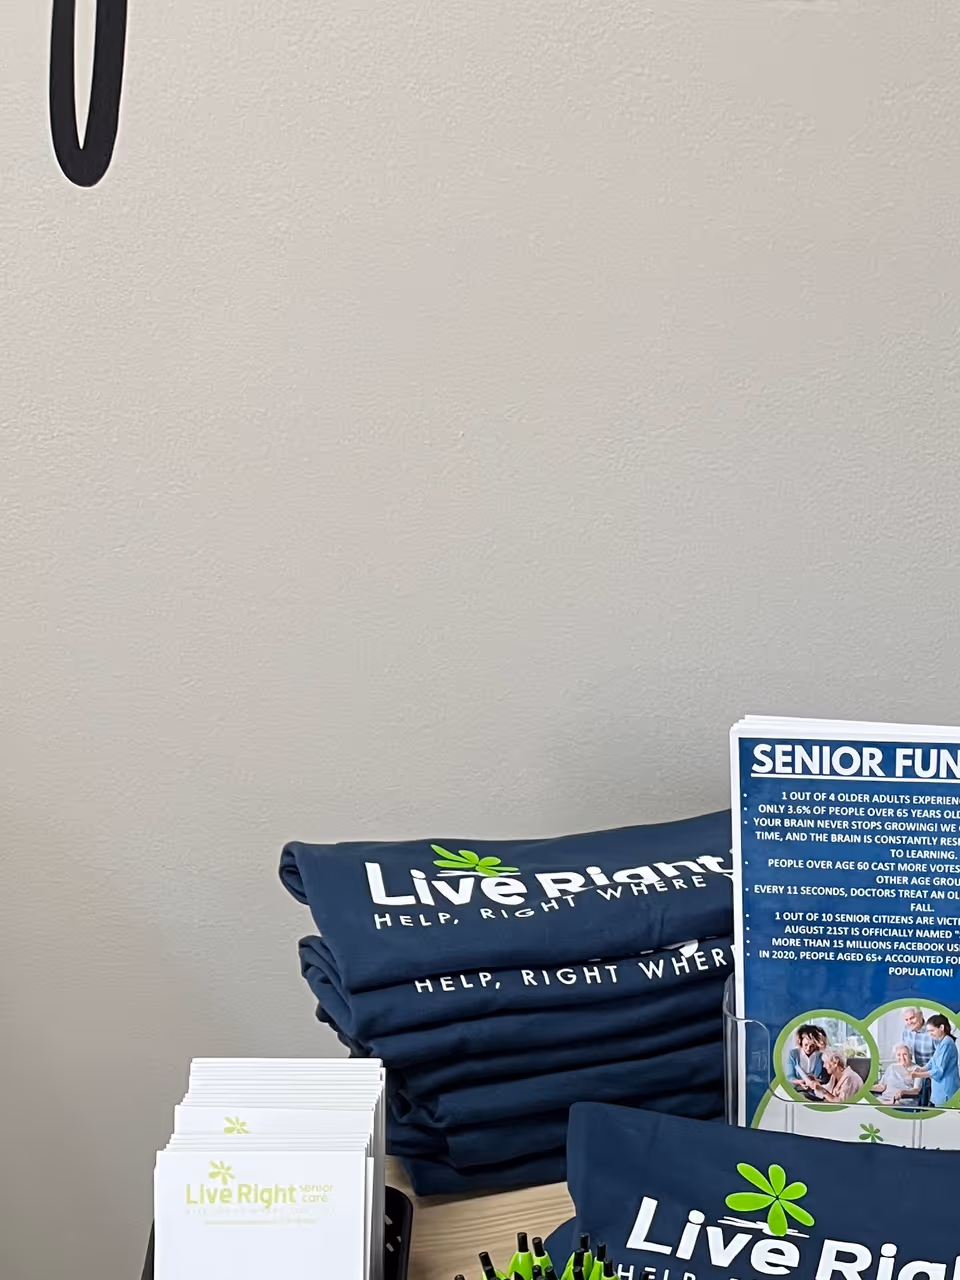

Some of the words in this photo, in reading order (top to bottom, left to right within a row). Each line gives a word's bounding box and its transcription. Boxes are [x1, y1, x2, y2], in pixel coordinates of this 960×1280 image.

[752, 744, 886, 776] SENIOR
[781, 791, 788, 801] 1
[789, 791, 812, 801] OUT
[813, 791, 827, 802] OF
[828, 792, 836, 802] 4
[837, 792, 870, 803] OLDER
[871, 794, 911, 804] ADULTS
[757, 803, 786, 814] ONLY
[787, 804, 811, 815] 3.6%
[812, 805, 827, 815] OF
[828, 806, 865, 817] PEOPLE
[867, 807, 895, 817] OVER
[896, 808, 909, 818] 65
[910, 808, 942, 819] YEARS
[753, 817, 782, 827] YOUR
[783, 818, 815, 829] BRAIN
[816, 819, 850, 830] NEVER
[851, 820, 883, 831] STOPS
[883, 821, 938, 833] GROWING!
[939, 823, 957, 833] WE
[754, 831, 783, 842] TIME,
[785, 831, 808, 842] AND
[809, 832, 829, 843] THE
[830, 833, 862, 843] BRAIN
[863, 834, 873, 844] IS
[874, 834, 939, 846] CONSTANTLY
[889, 848, 905, 859] TO
[905, 849, 959, 860] LEARNING.
[767, 858, 805, 869] PEOPLE
[805, 859, 833, 870] OVER
[834, 860, 855, 871] AGE
[856, 861, 870, 871] 60
[870, 861, 896, 871] CAST
[897, 862, 928, 873] MORE
[929, 863, 960, 874] VOTES
[364, 861, 529, 907] Live
[875, 875, 909, 885] OTHER
[910, 876, 931, 886] AGE
[373, 912, 459, 930] HELP,
[481, 895, 576, 919] RIGHT
[597, 876, 706, 900] WHERE
[775, 911, 781, 921] 1
[782, 911, 805, 921] OUT
[805, 912, 819, 922] OF
[821, 913, 833, 922] 10
[834, 913, 871, 923] SENIOR
[872, 914, 914, 925] CITIZENS
[915, 916, 935, 925] ARE
[784, 925, 825, 935] AUGUST
[826, 926, 850, 936] 21ST
[850, 927, 860, 936] IS
[861, 927, 914, 938] OFFICIALLY
[915, 929, 953, 939] NAMED
[771, 937, 802, 947] MORE
[802, 938, 831, 948] THAN
[832, 939, 845, 949] 15
[845, 939, 892, 950] MILLIONS
[893, 941, 945, 952] FACEBOOK
[759, 949, 770, 959] IN
[771, 949, 798, 961] 2020,
[799, 951, 835, 961] PEOPLE
[836, 952, 864, 962] AGED
[865, 953, 883, 962] 65+
[884, 953, 944, 965] ACCOUNTED
[415, 971, 501, 993] HELP,
[522, 965, 617, 986] RIGHT
[638, 944, 736, 980] WHER
[888, 966, 953, 978] POPULATION!
[186, 1184, 233, 1205] Live
[237, 1184, 297, 1209] Right
[626, 1196, 800, 1275] Live
